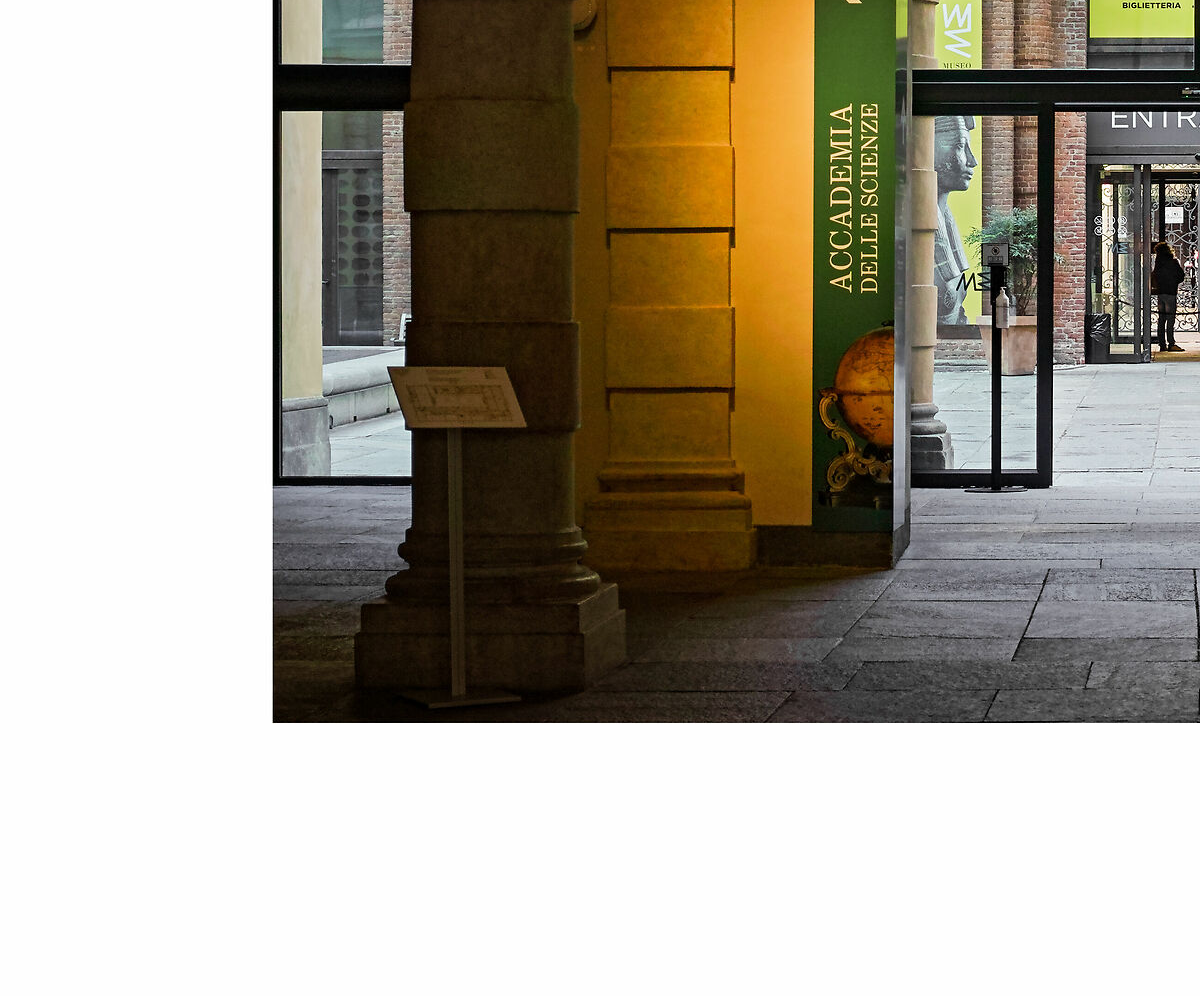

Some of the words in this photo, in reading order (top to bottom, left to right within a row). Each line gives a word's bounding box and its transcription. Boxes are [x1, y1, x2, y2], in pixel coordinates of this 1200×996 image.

[829, 103, 853, 294] ACCADEMIA
[860, 103, 879, 207] SCIENZE
[860, 213, 879, 294] DELLE
